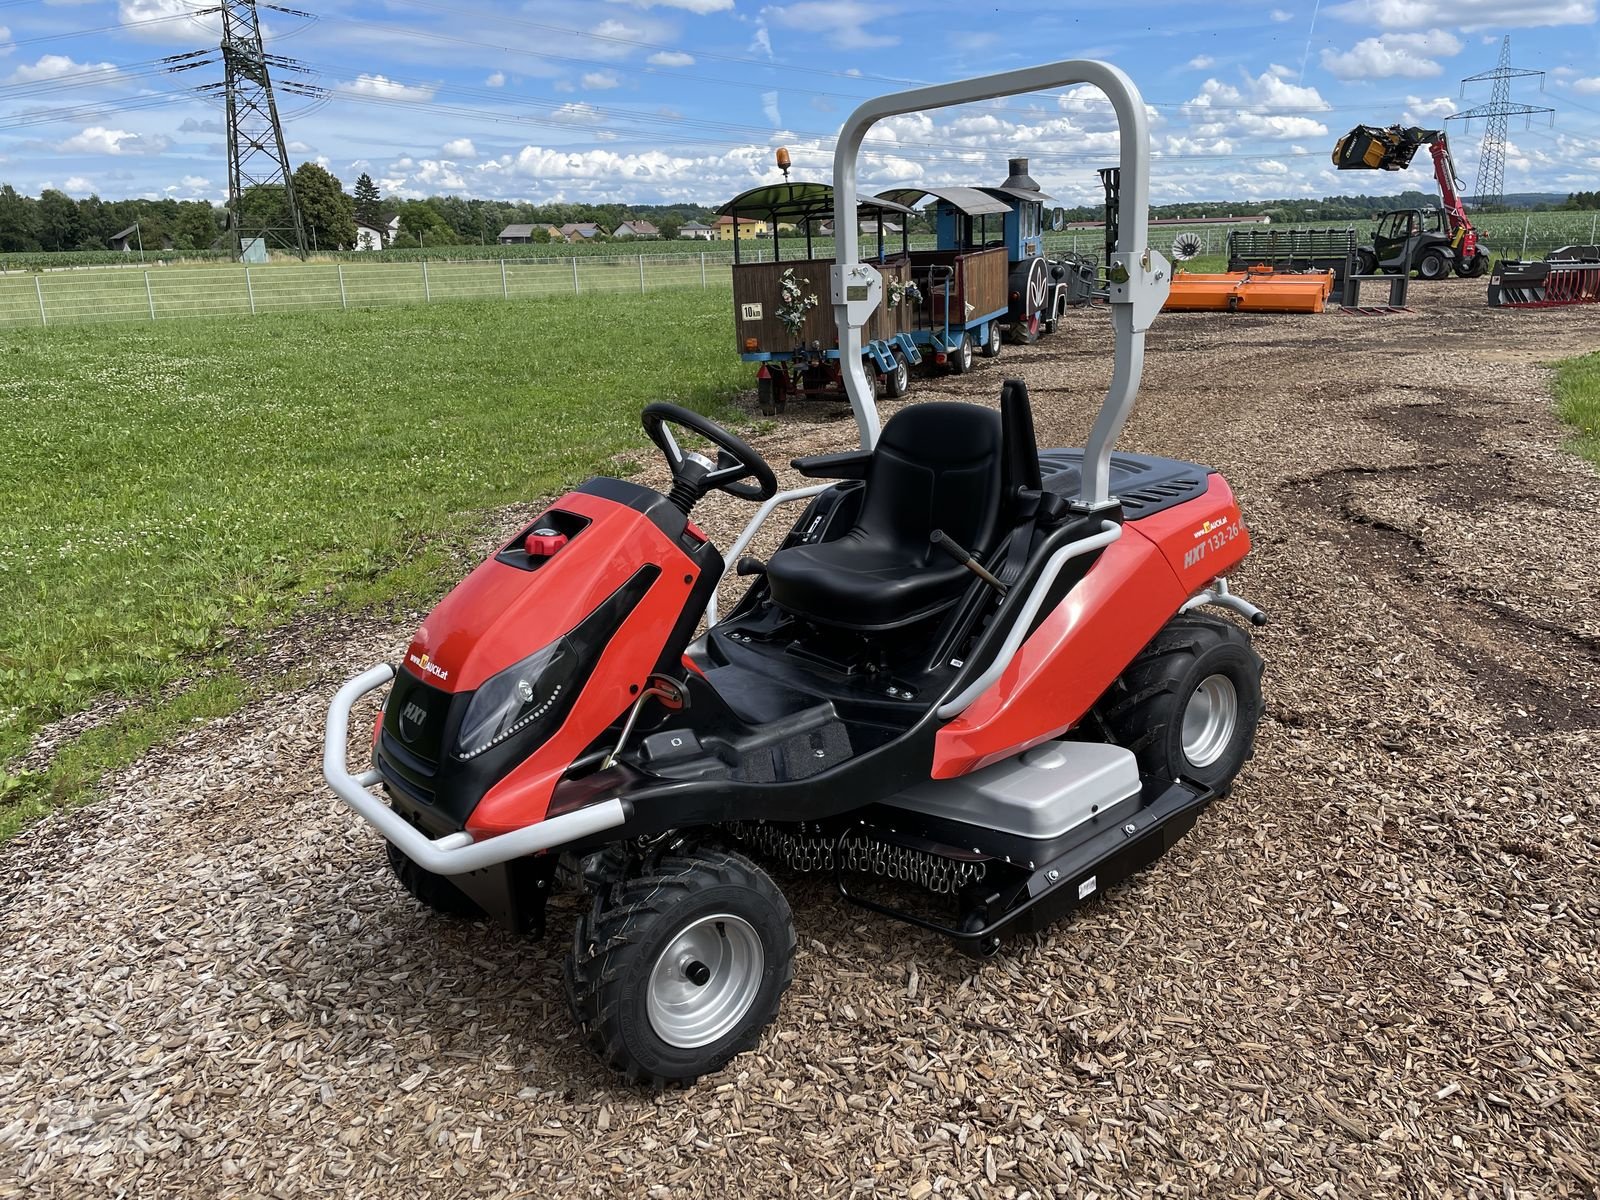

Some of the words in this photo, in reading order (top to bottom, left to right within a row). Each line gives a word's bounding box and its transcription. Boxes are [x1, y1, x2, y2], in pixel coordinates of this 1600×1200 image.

[744, 306, 753, 318] 10
[753, 309, 761, 317] km
[1184, 541, 1206, 570] HXT
[1207, 522, 1239, 552] 132-26
[403, 701, 428, 726] HXT
